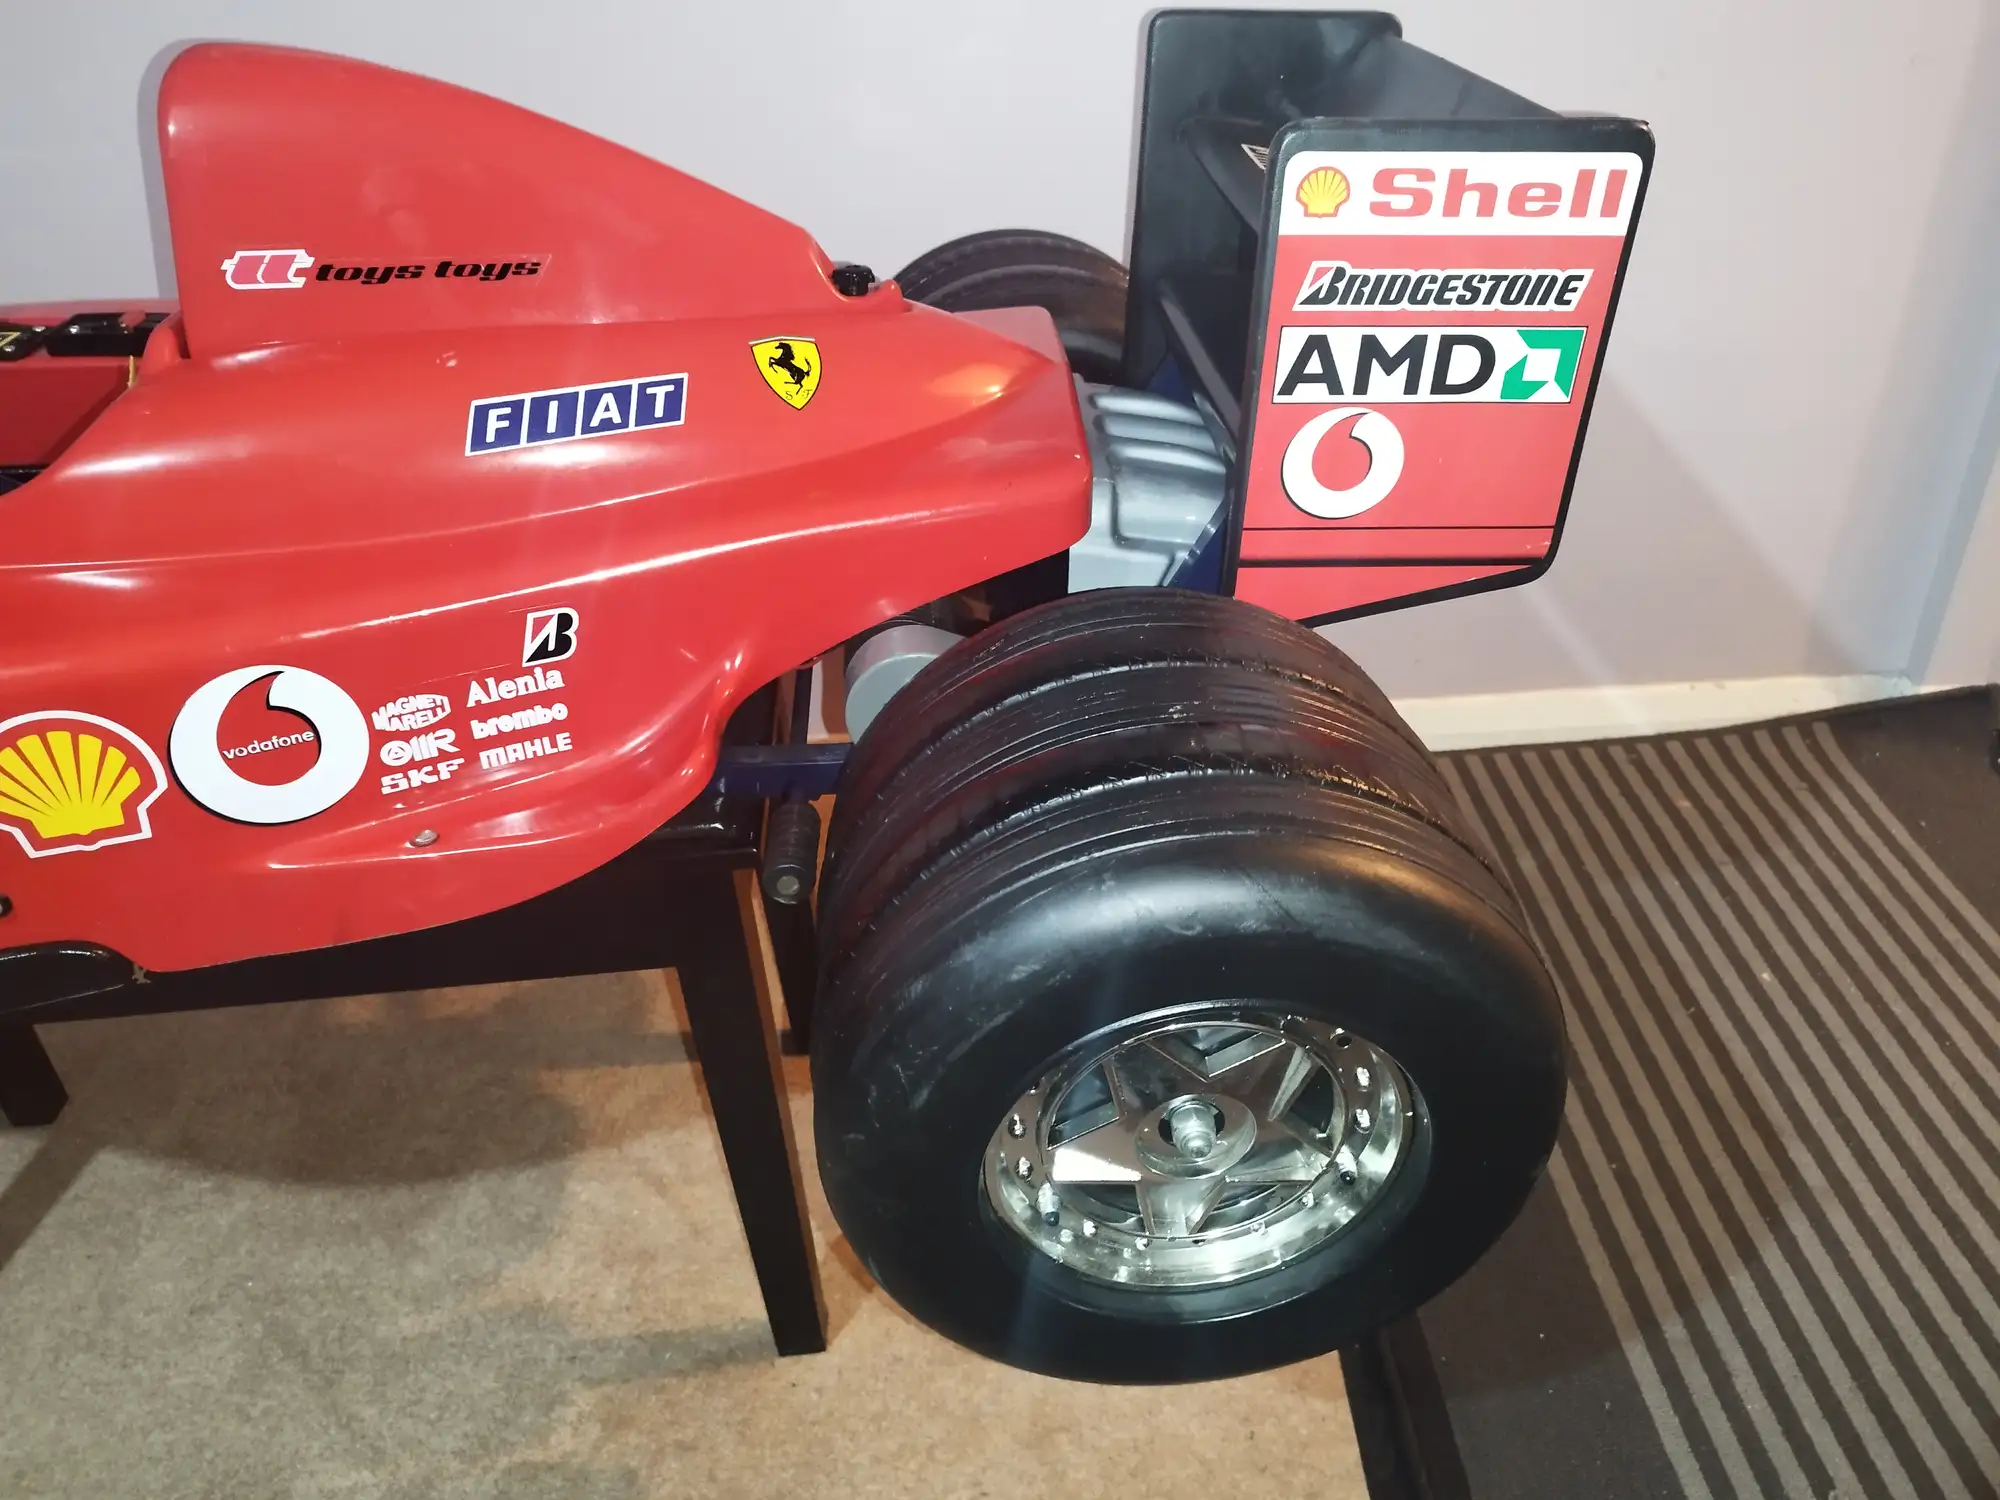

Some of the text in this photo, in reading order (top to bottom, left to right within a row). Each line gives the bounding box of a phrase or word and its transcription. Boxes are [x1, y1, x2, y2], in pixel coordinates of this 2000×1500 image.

[1369, 167, 1628, 218] Shell
[316, 263, 426, 285] toys
[434, 260, 541, 281] toys
[1298, 264, 1584, 308] BRIDGESTONE
[1277, 334, 1496, 396] AMD
[485, 384, 676, 443] FIAT
[466, 667, 565, 707] Alenia
[222, 730, 315, 759] vodafone
[479, 732, 573, 770] MAHLE
[381, 758, 465, 795] SKF
